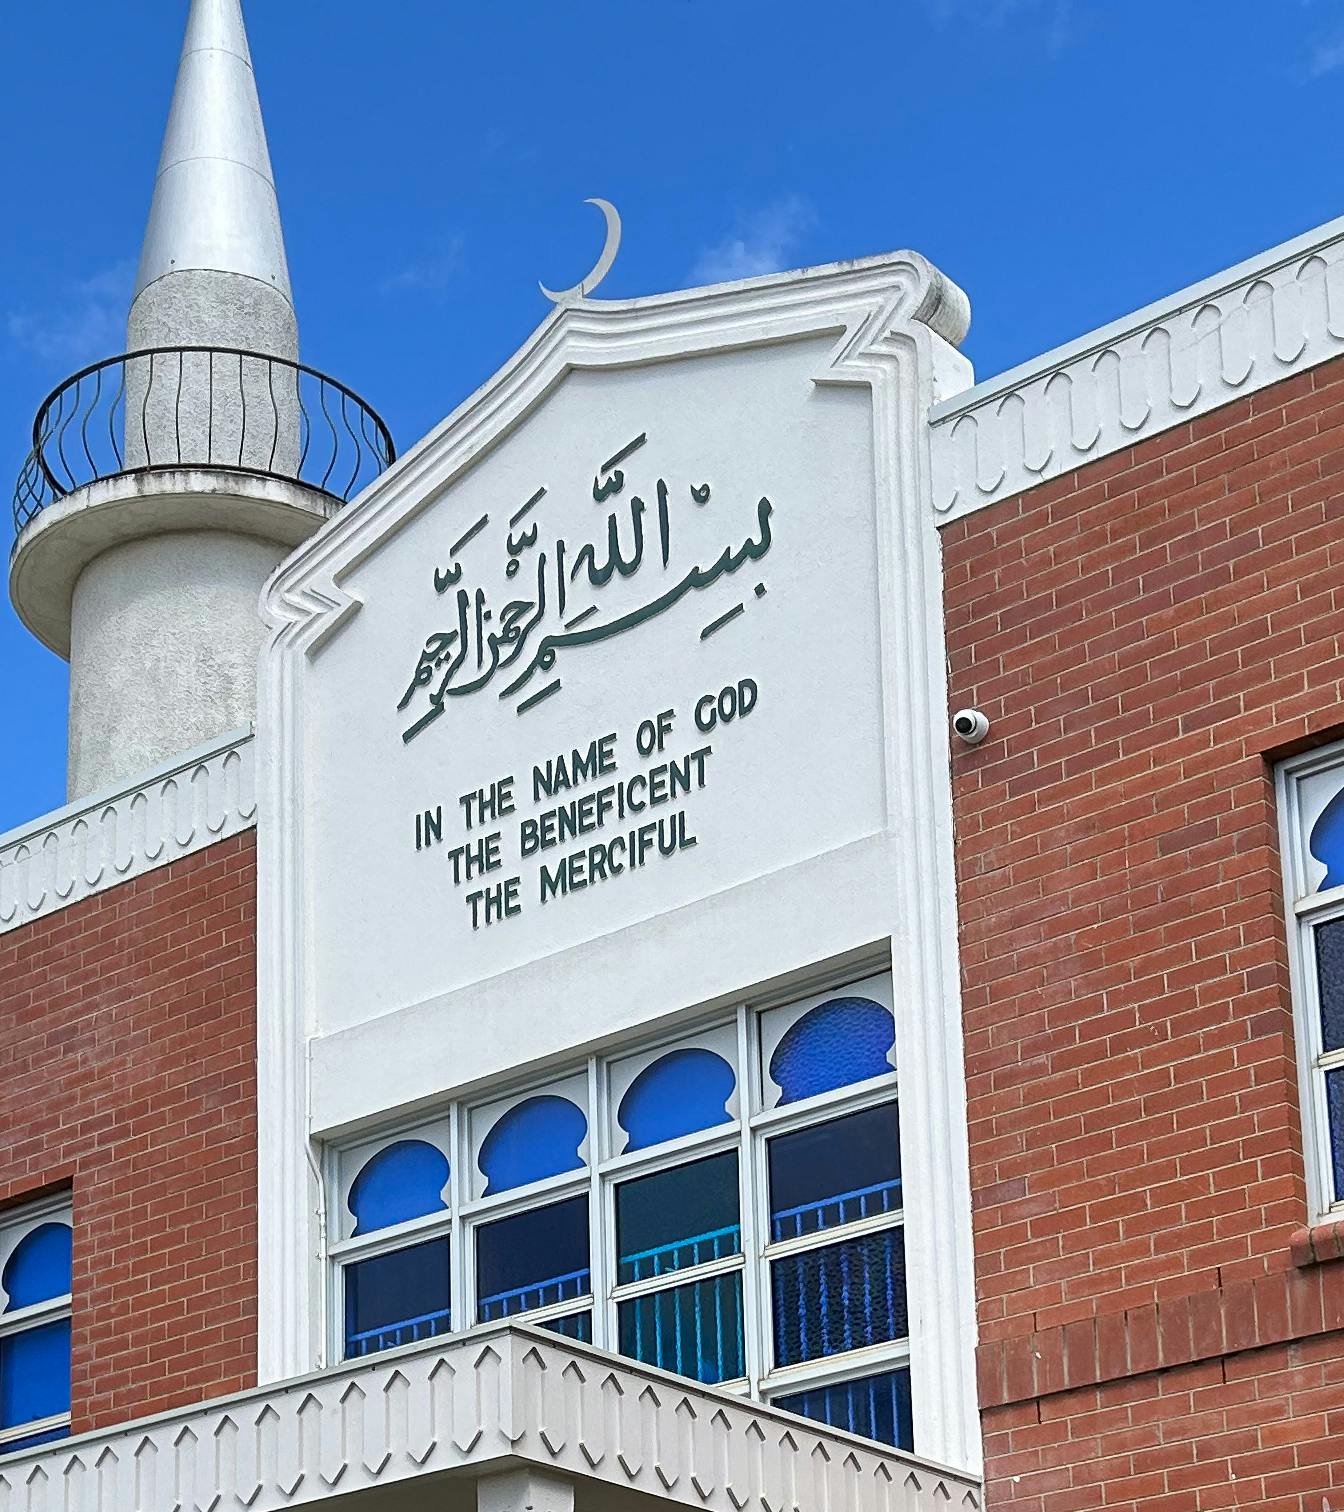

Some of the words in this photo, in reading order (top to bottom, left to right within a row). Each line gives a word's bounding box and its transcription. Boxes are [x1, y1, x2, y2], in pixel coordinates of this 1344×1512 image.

[415, 806, 444, 851] IN
[459, 775, 518, 831] THE
[532, 733, 618, 804] NAME
[635, 709, 677, 758] OF
[694, 678, 758, 735] GOD
[447, 831, 503, 886] THE
[520, 746, 713, 859] BENEFICENT
[465, 876, 522, 931] THE
[539, 811, 698, 905] MERCIFUL
